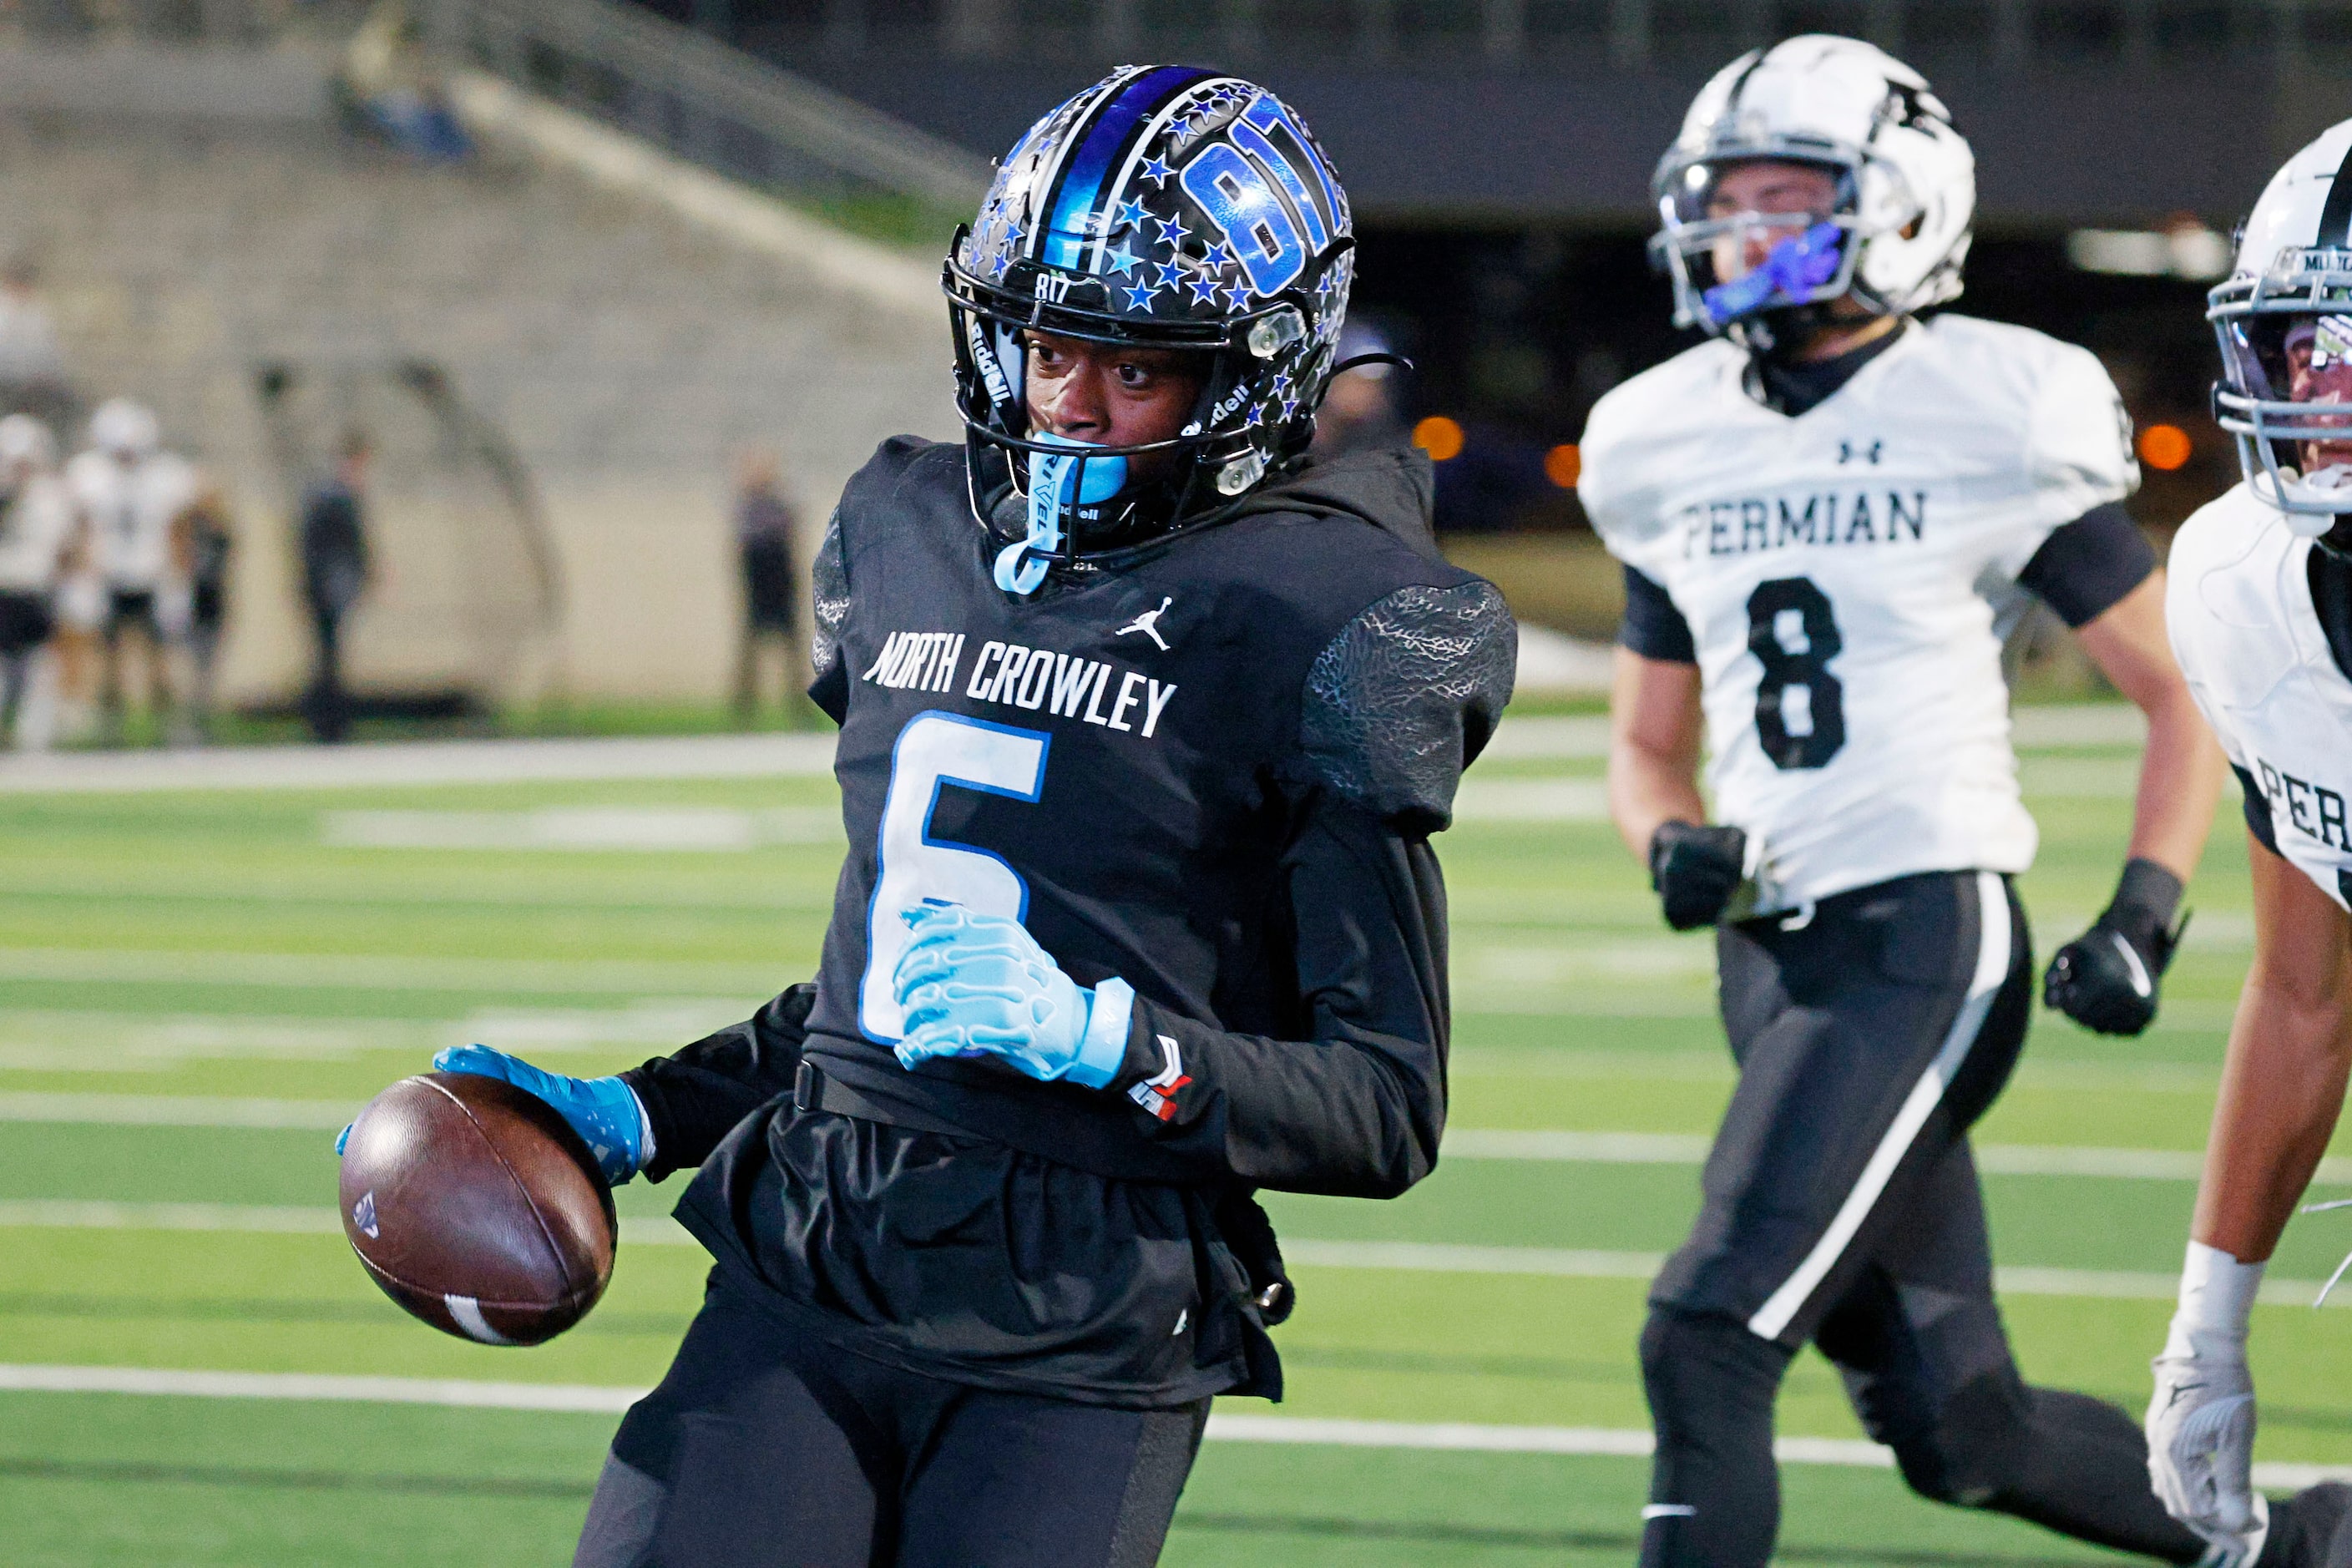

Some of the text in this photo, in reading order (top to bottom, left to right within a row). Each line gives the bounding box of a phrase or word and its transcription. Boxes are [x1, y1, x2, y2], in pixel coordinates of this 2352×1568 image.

[1178, 89, 1344, 299] 817
[971, 322, 1011, 402] Riddell
[1682, 492, 1928, 558] PERMIAN
[862, 631, 1178, 738] NORTH CROWLEY
[1747, 576, 1846, 771] 8
[858, 709, 1052, 1055] 6
